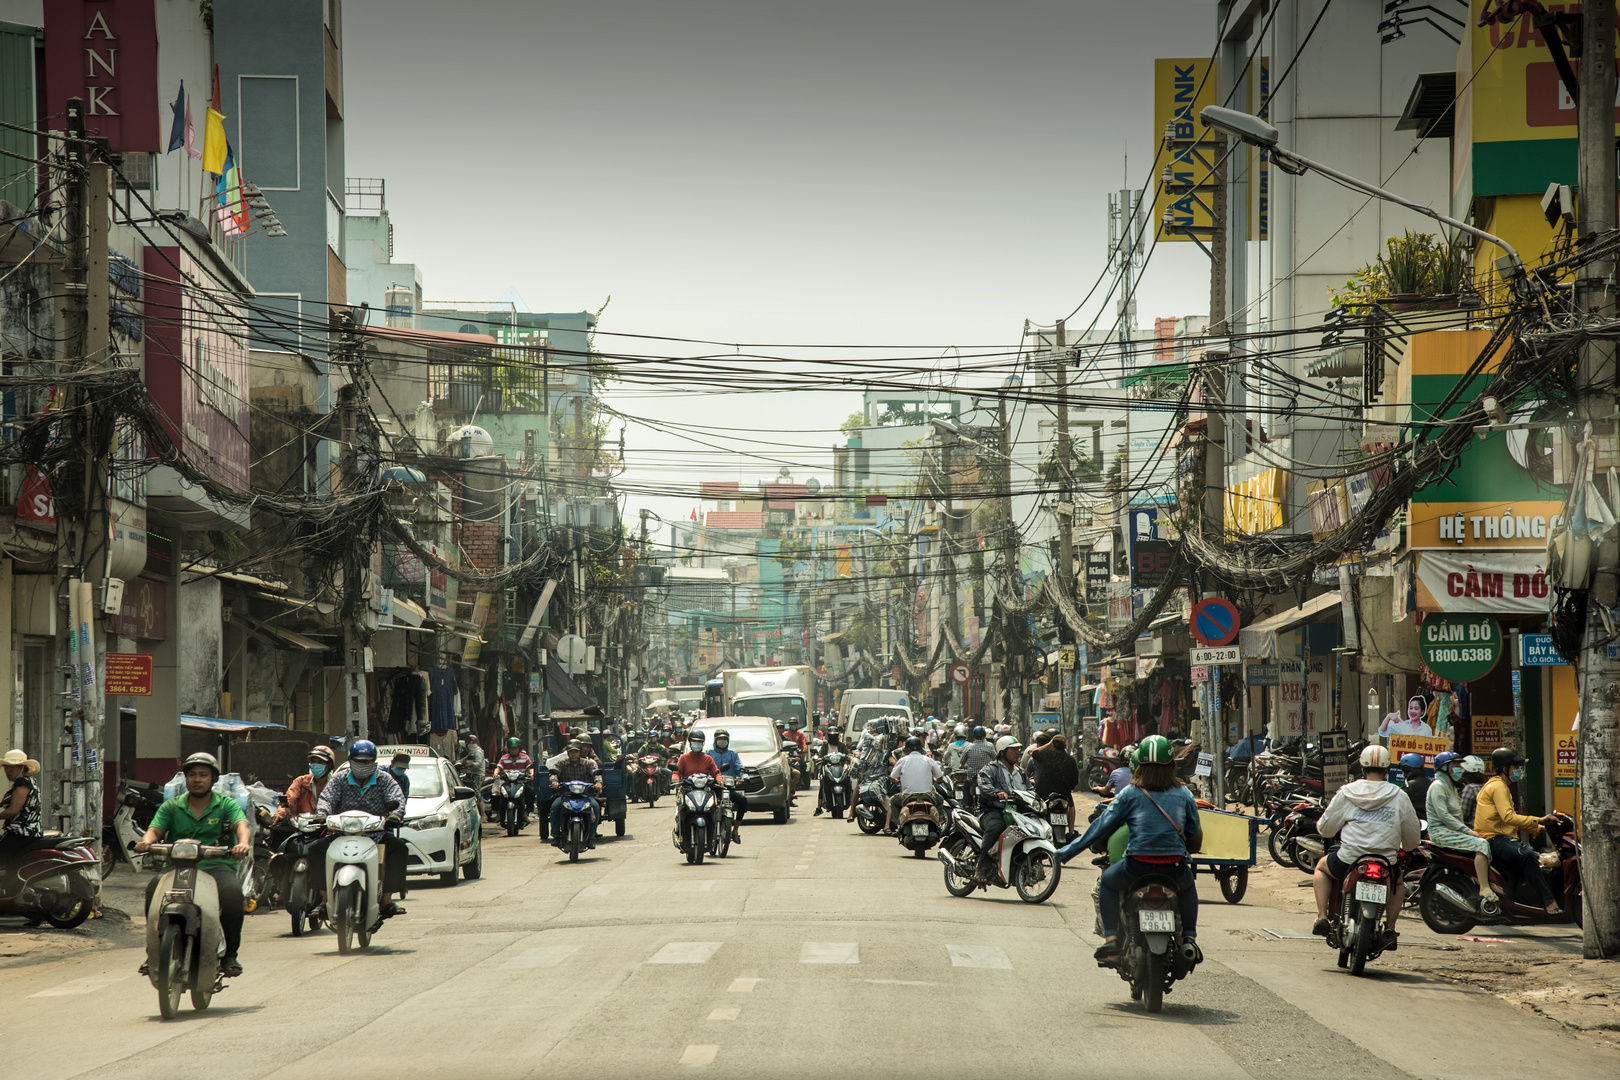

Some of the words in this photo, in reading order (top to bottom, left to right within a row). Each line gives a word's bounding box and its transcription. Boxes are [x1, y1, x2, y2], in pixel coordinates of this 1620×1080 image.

[1174, 63, 1195, 139] BANK
[1439, 511, 1466, 544] HỆ
[1470, 506, 1546, 539] THỐNG
[1447, 564, 1503, 598] CẦM
[1512, 565, 1549, 598] ĐỒ
[1427, 619, 1465, 642] CẦM
[1468, 618, 1492, 641] ĐỒ
[1060, 653, 1069, 662] 4
[1196, 650, 1236, 661] 6:00-22:00
[1428, 648, 1492, 662] 1800.6388
[1529, 644, 1546, 655] BẢY
[1281, 681, 1320, 701] PHT
[1289, 711, 1314, 731] TI
